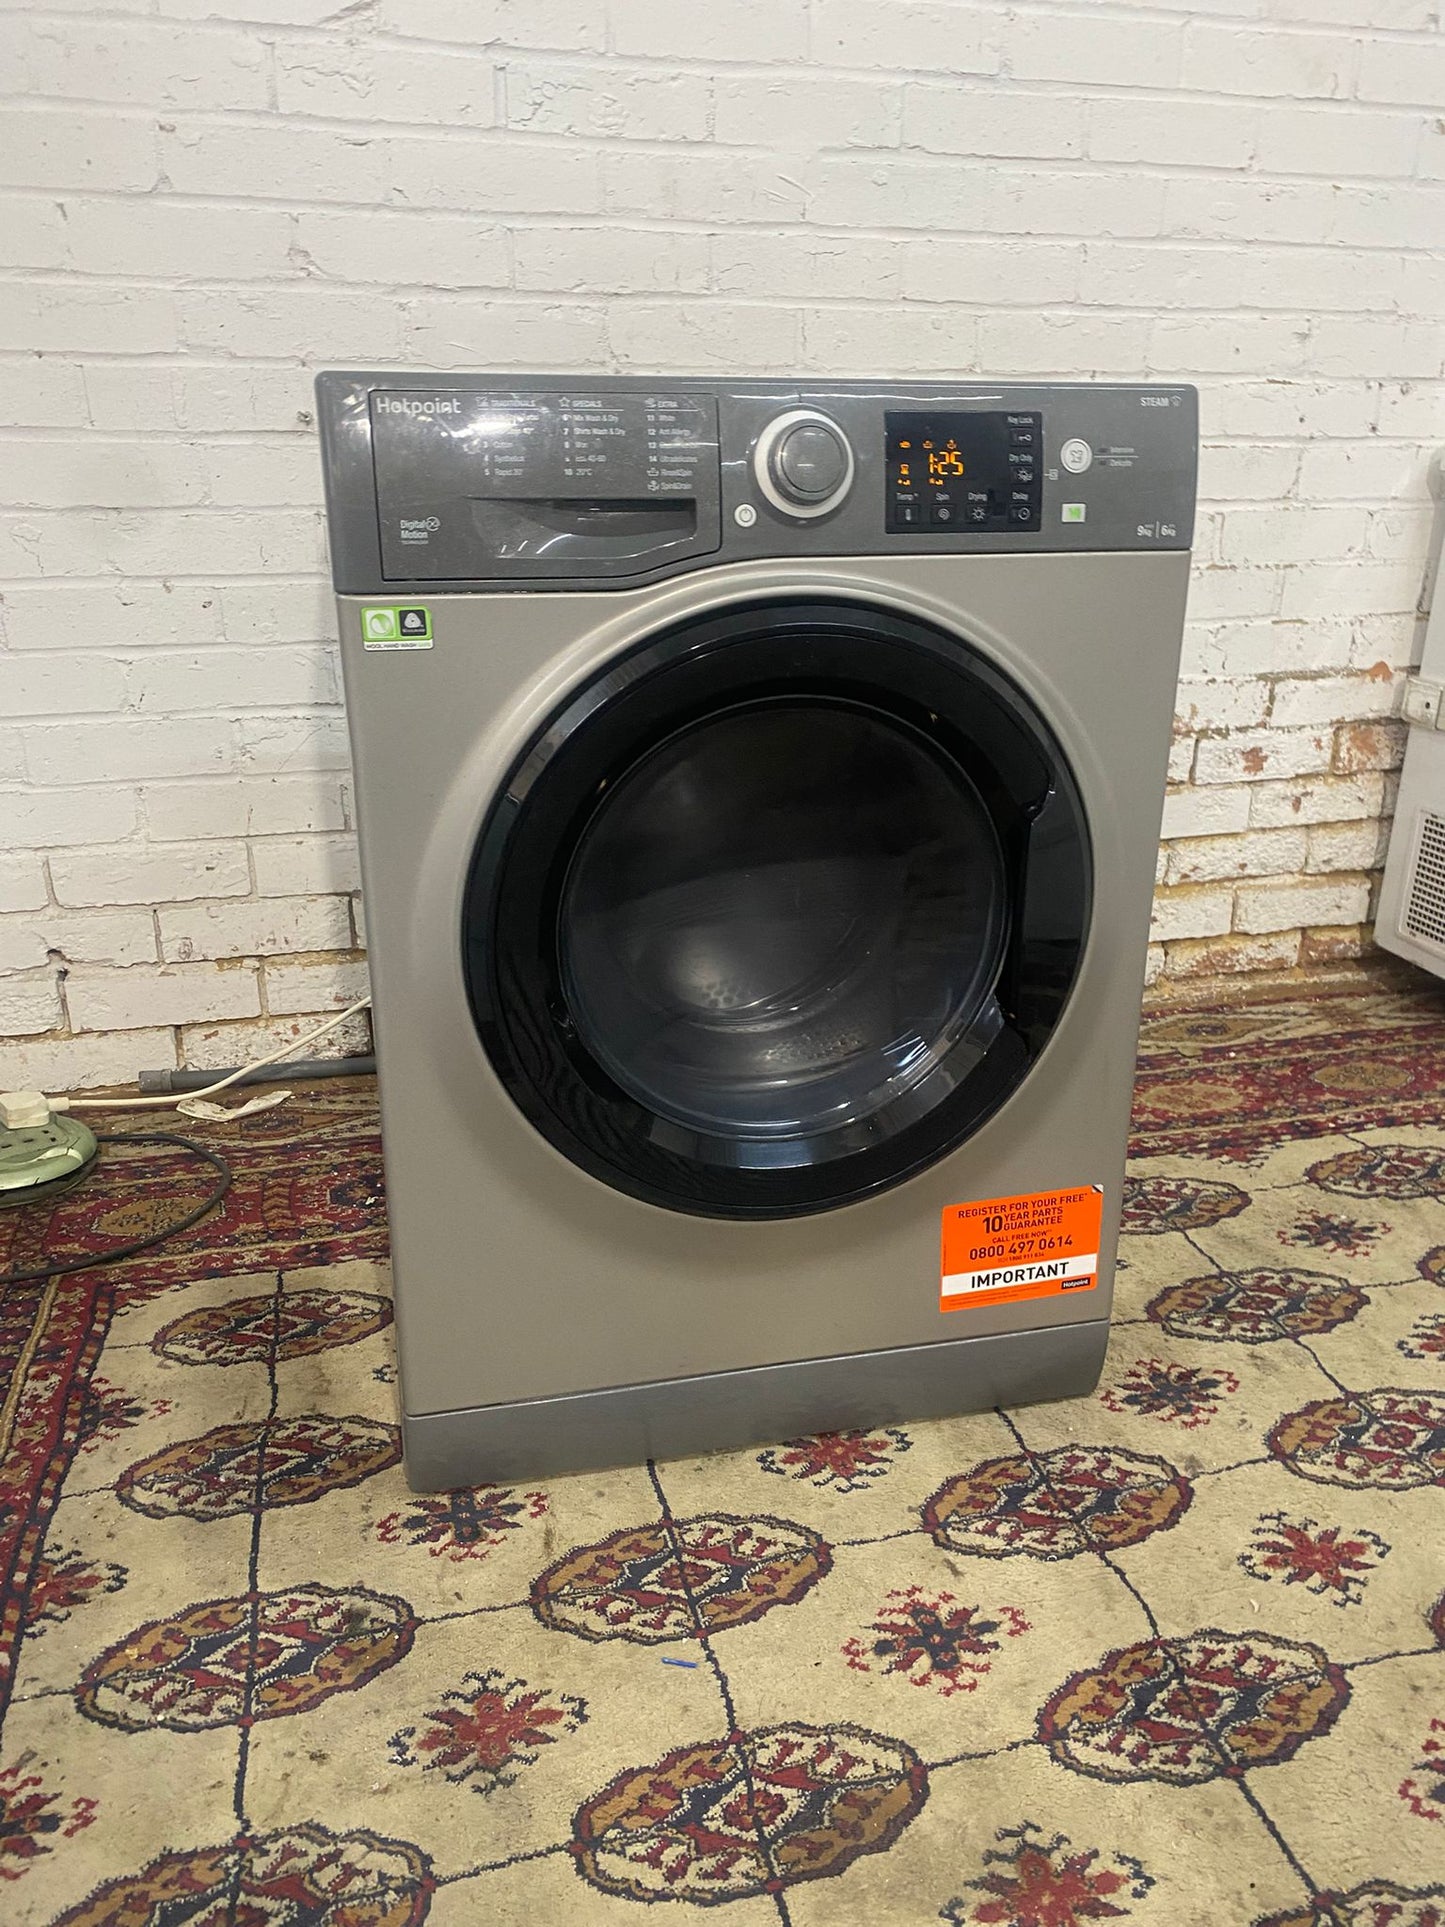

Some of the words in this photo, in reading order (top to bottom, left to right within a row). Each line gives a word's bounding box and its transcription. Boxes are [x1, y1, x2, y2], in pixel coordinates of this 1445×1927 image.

[376, 397, 462, 416] Hotpoint
[1140, 397, 1169, 407] STEAM
[929, 451, 965, 476] 1:25
[400, 519, 426, 531] Digital
[400, 530, 428, 539] Motion
[958, 1204, 1007, 1219] REGISTER
[1009, 1201, 1029, 1212] FOR
[1031, 1198, 1057, 1209] YOUR
[1004, 1211, 1030, 1222] YEAR
[1032, 1206, 1063, 1218] PARTS
[982, 1215, 1003, 1234] 10
[1003, 1215, 1063, 1231] GUARANTEE
[992, 1236, 1010, 1244] CALL
[1011, 1232, 1029, 1241] FREE
[969, 1244, 1005, 1261] 0800
[1008, 1240, 1035, 1255] 497
[1038, 1234, 1073, 1251] 0614
[971, 1261, 1070, 1289] IMPORTANT
[1062, 1278, 1089, 1289] Hotpoint
